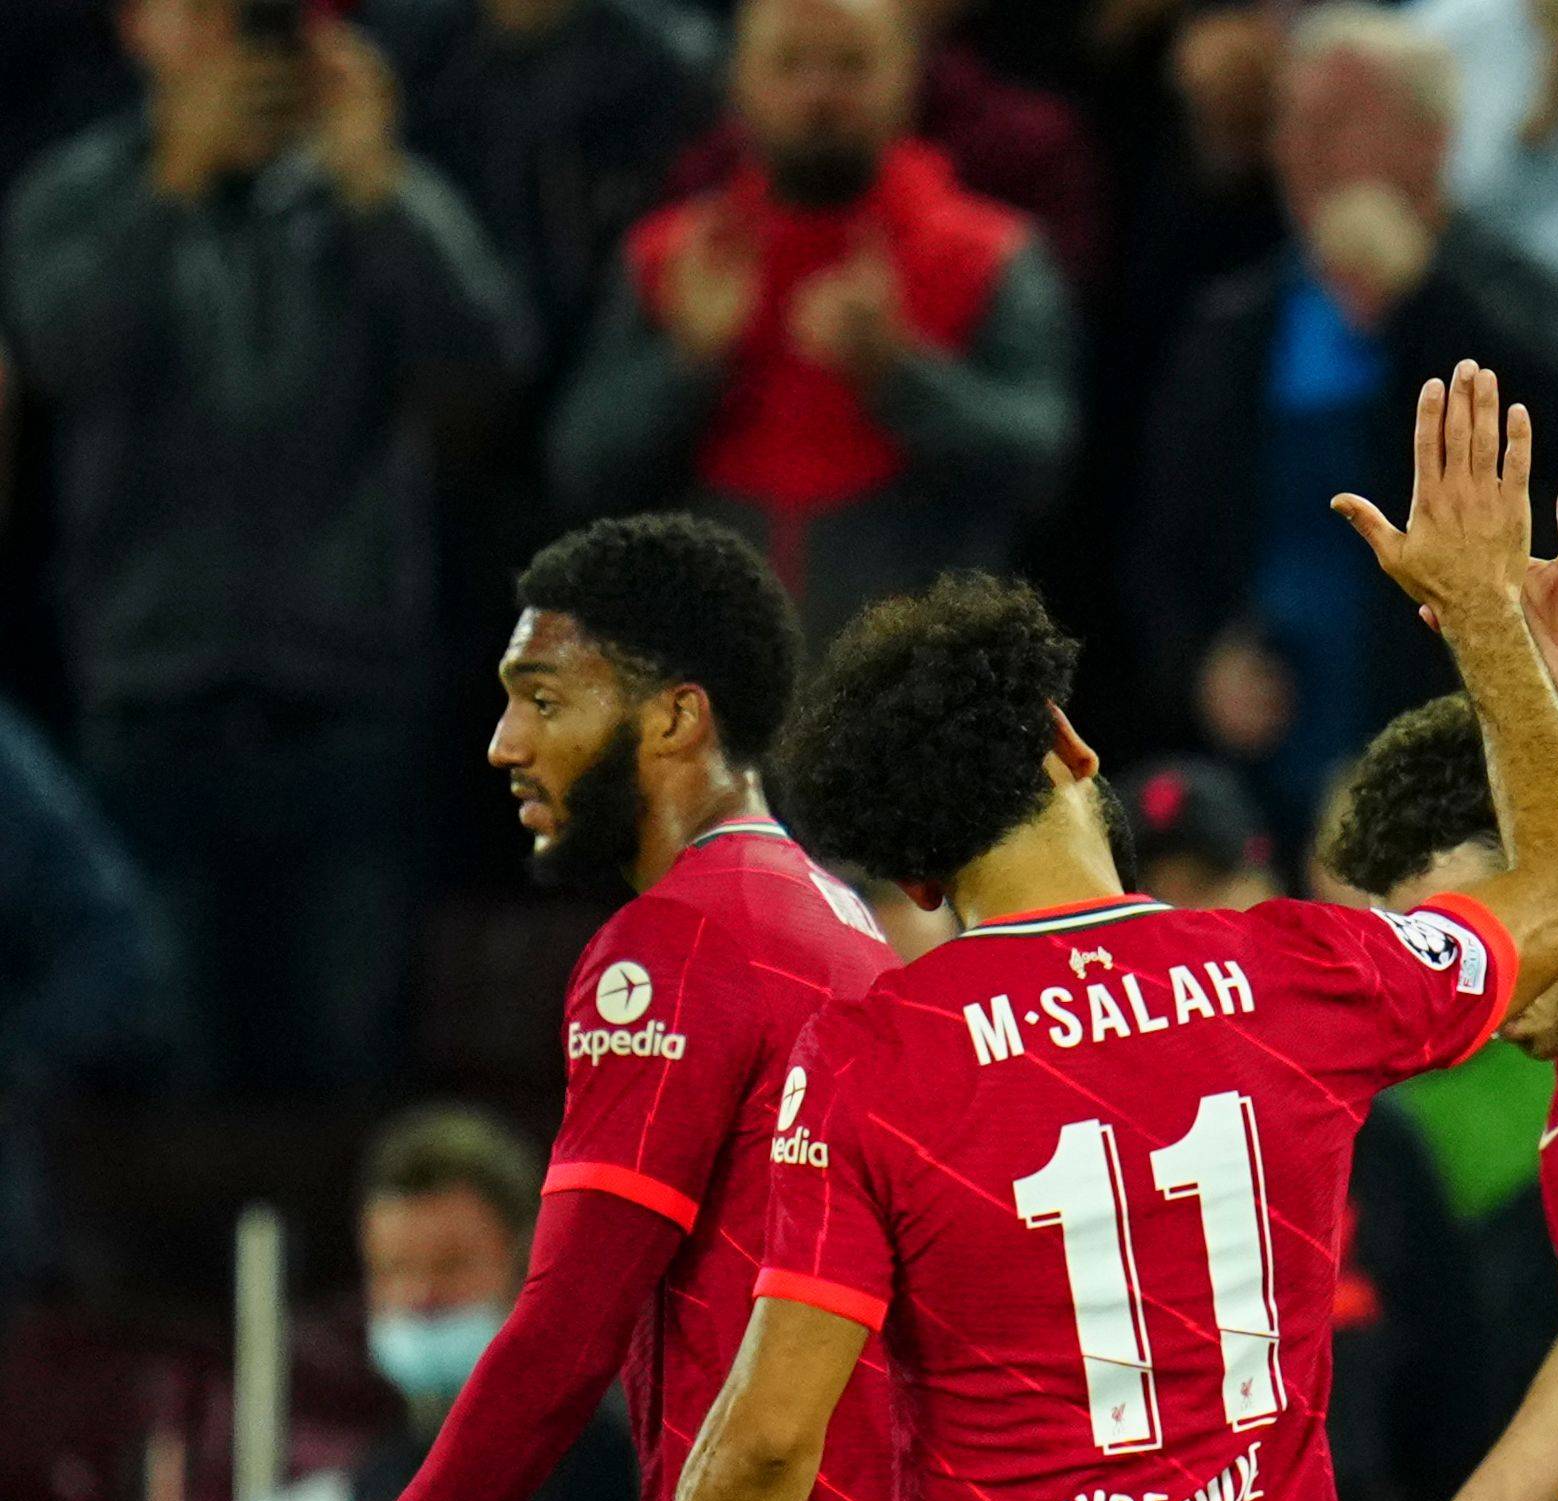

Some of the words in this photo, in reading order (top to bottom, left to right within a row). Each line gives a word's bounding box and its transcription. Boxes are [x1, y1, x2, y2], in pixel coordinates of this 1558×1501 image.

[568, 1020, 686, 1067] Expedia
[770, 1126, 829, 1168] edia
[1013, 1090, 1287, 1456] 11
